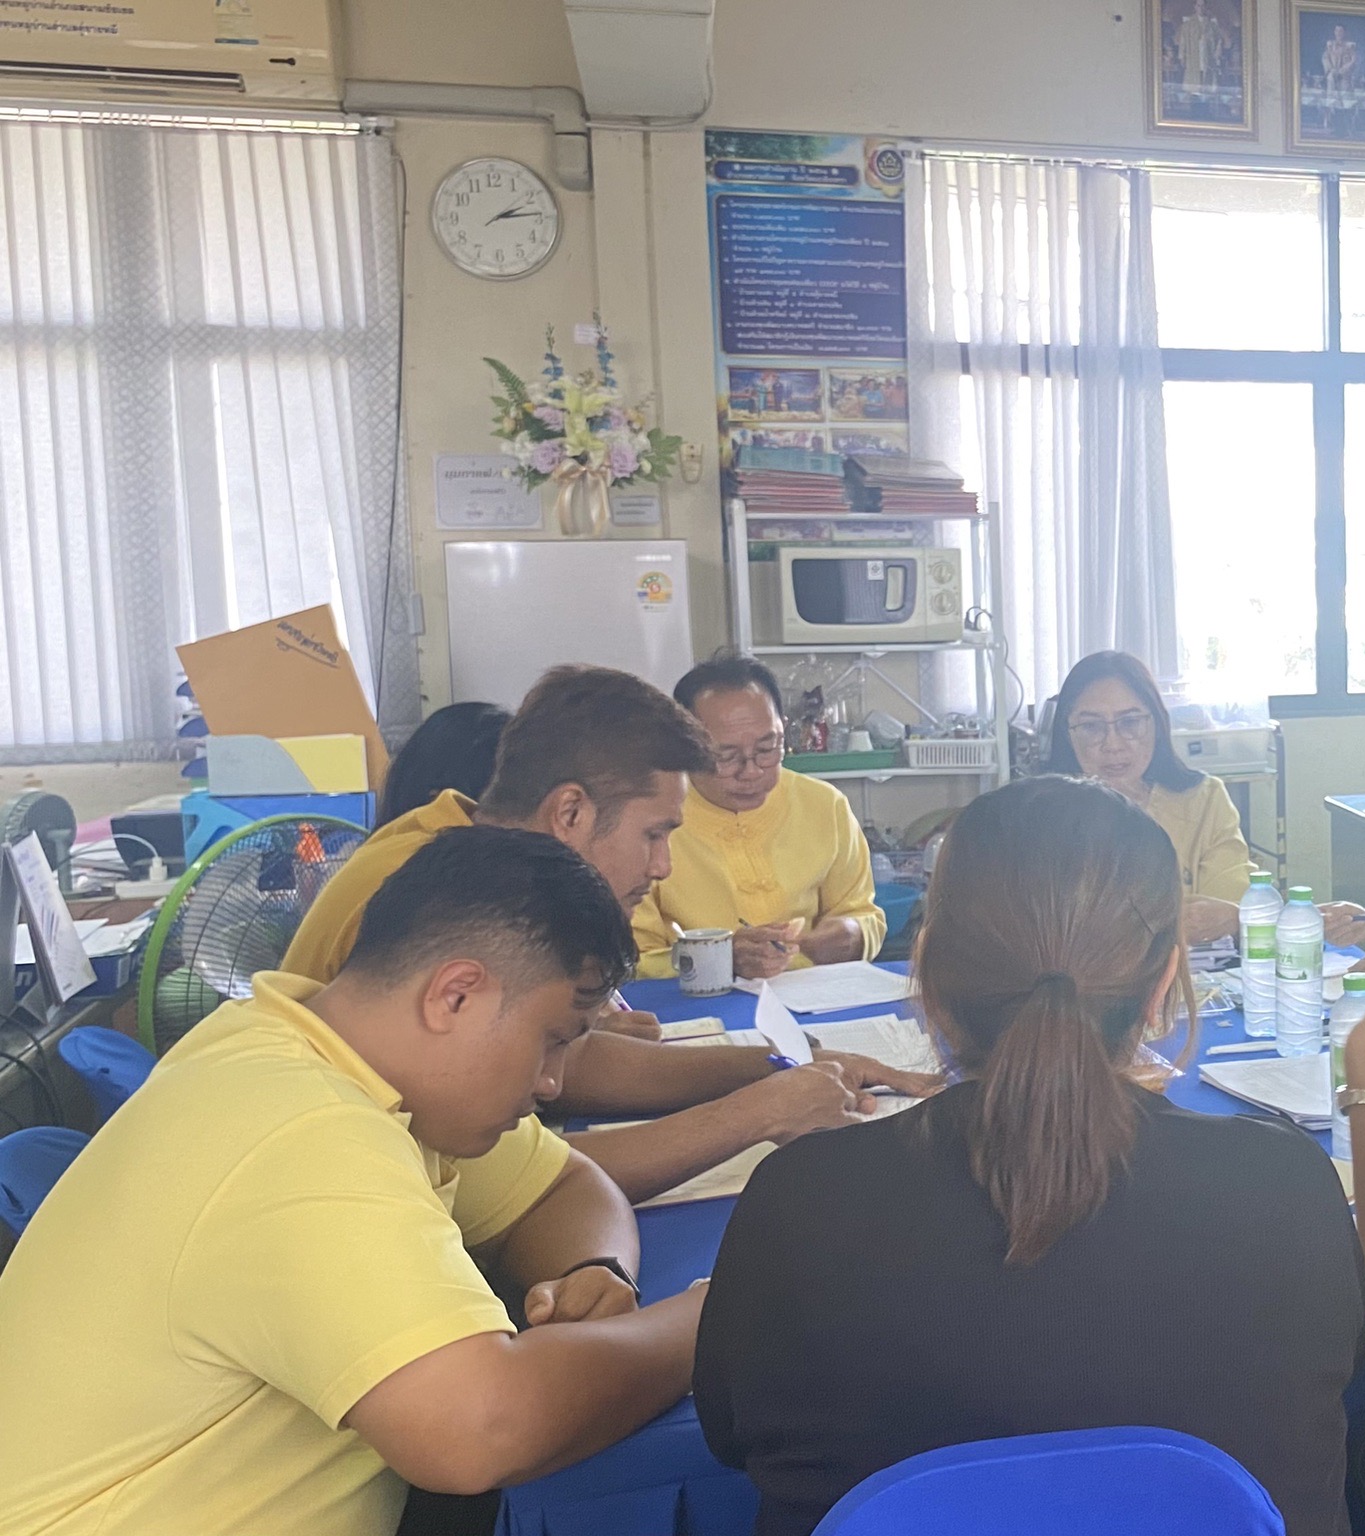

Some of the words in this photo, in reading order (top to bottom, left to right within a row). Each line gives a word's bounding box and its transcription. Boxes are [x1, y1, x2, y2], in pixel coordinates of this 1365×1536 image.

[469, 178, 480, 193] 11
[486, 173, 501, 188] 12
[511, 178, 517, 192] 1
[455, 192, 470, 207] 10
[525, 191, 535, 205] 2
[450, 212, 459, 226] 9
[458, 230, 467, 245] 8
[529, 229, 536, 243] 4
[474, 244, 483, 258] 7
[496, 249, 504, 262] 6
[516, 244, 525, 258] 5
